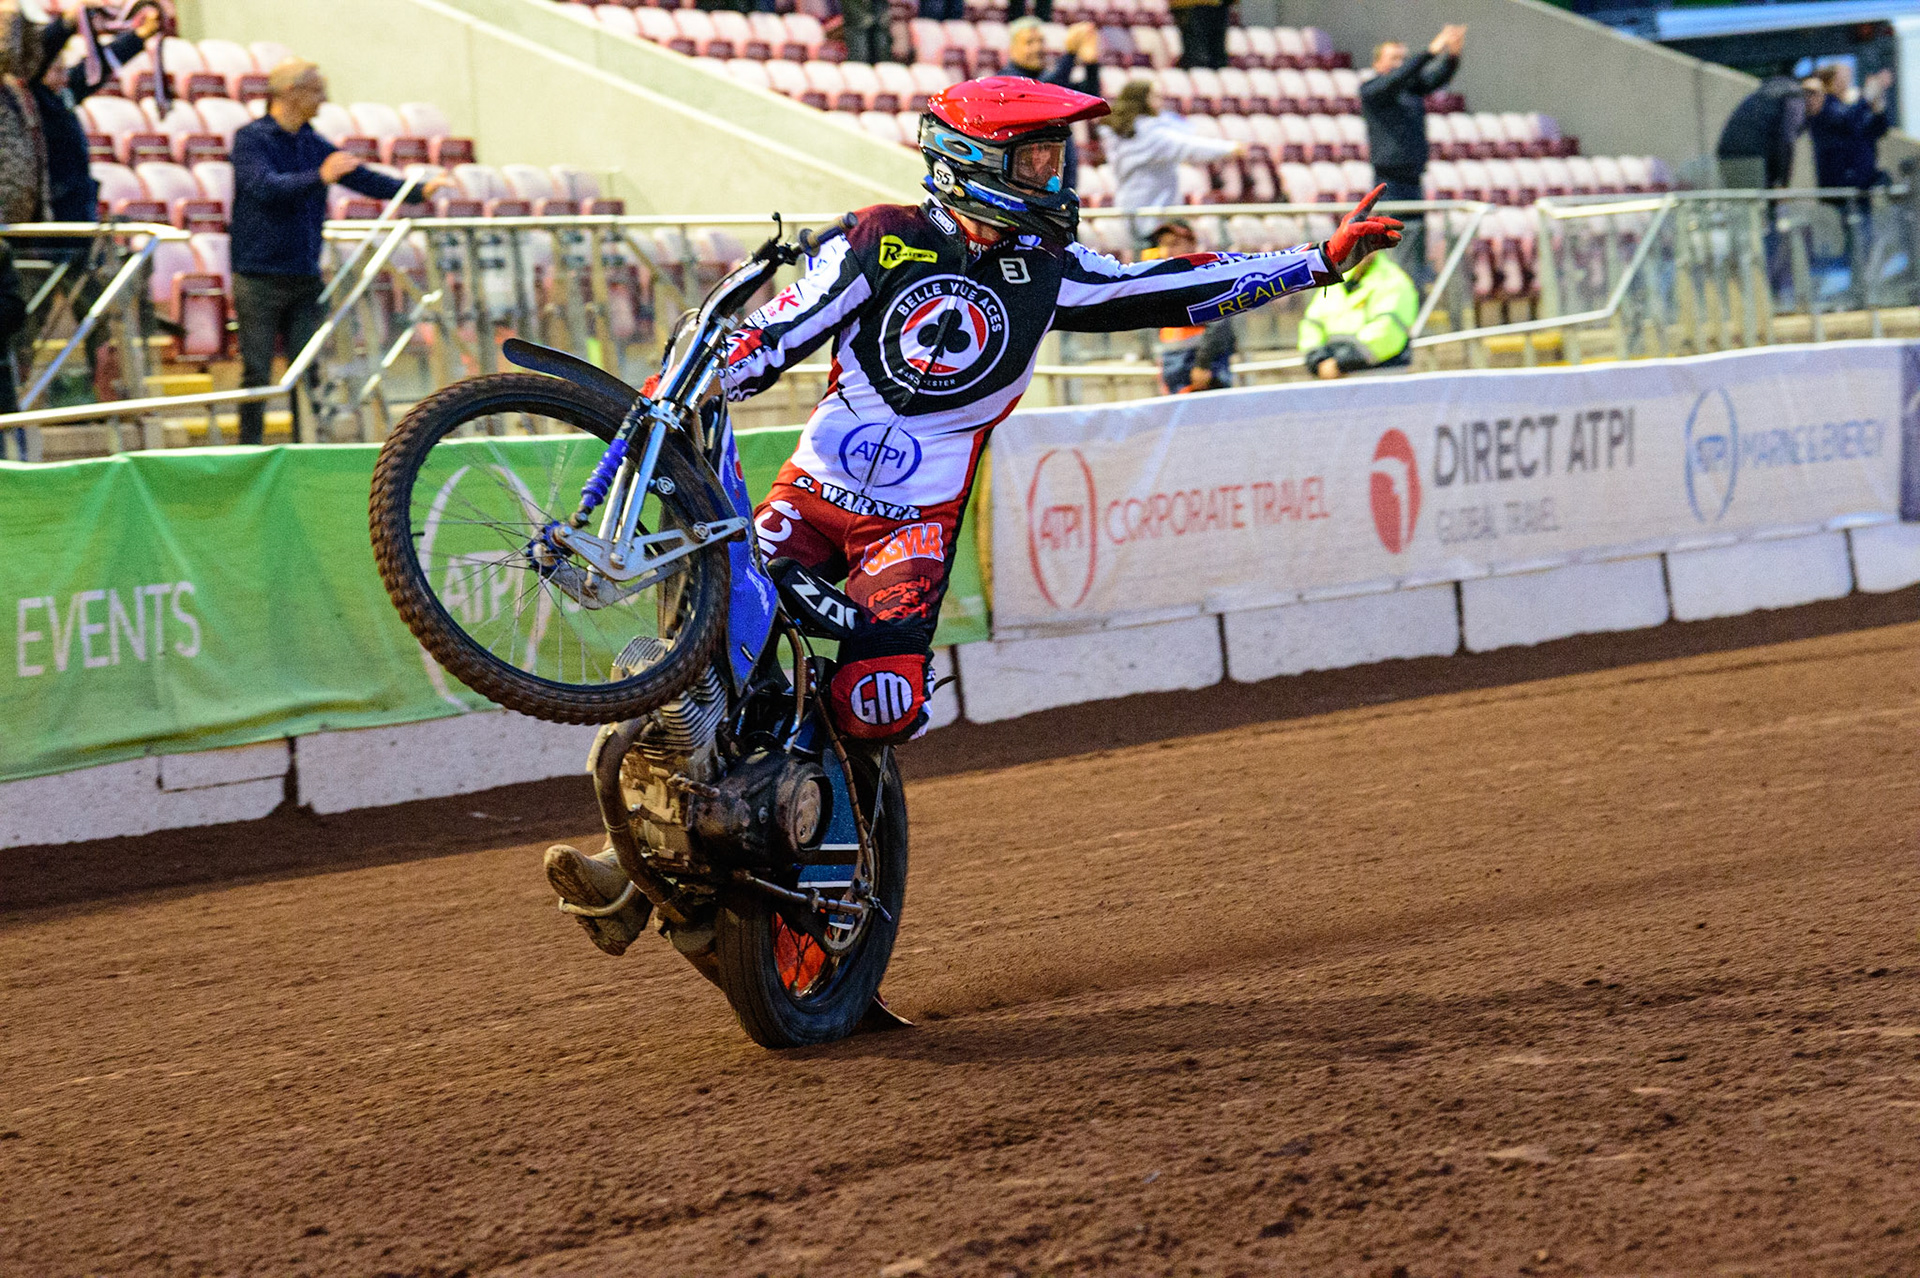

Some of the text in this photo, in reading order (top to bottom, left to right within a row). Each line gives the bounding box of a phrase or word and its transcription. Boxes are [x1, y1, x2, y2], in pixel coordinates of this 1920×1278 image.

[897, 281, 1003, 333] BELLE VUE ACES
[850, 440, 907, 469] ATPI
[1434, 406, 1636, 488] DIRECT ATPI
[1105, 475, 1331, 546] CORPORATE TRAVEL
[17, 581, 201, 677] EVENTS
[851, 671, 913, 725] GM
